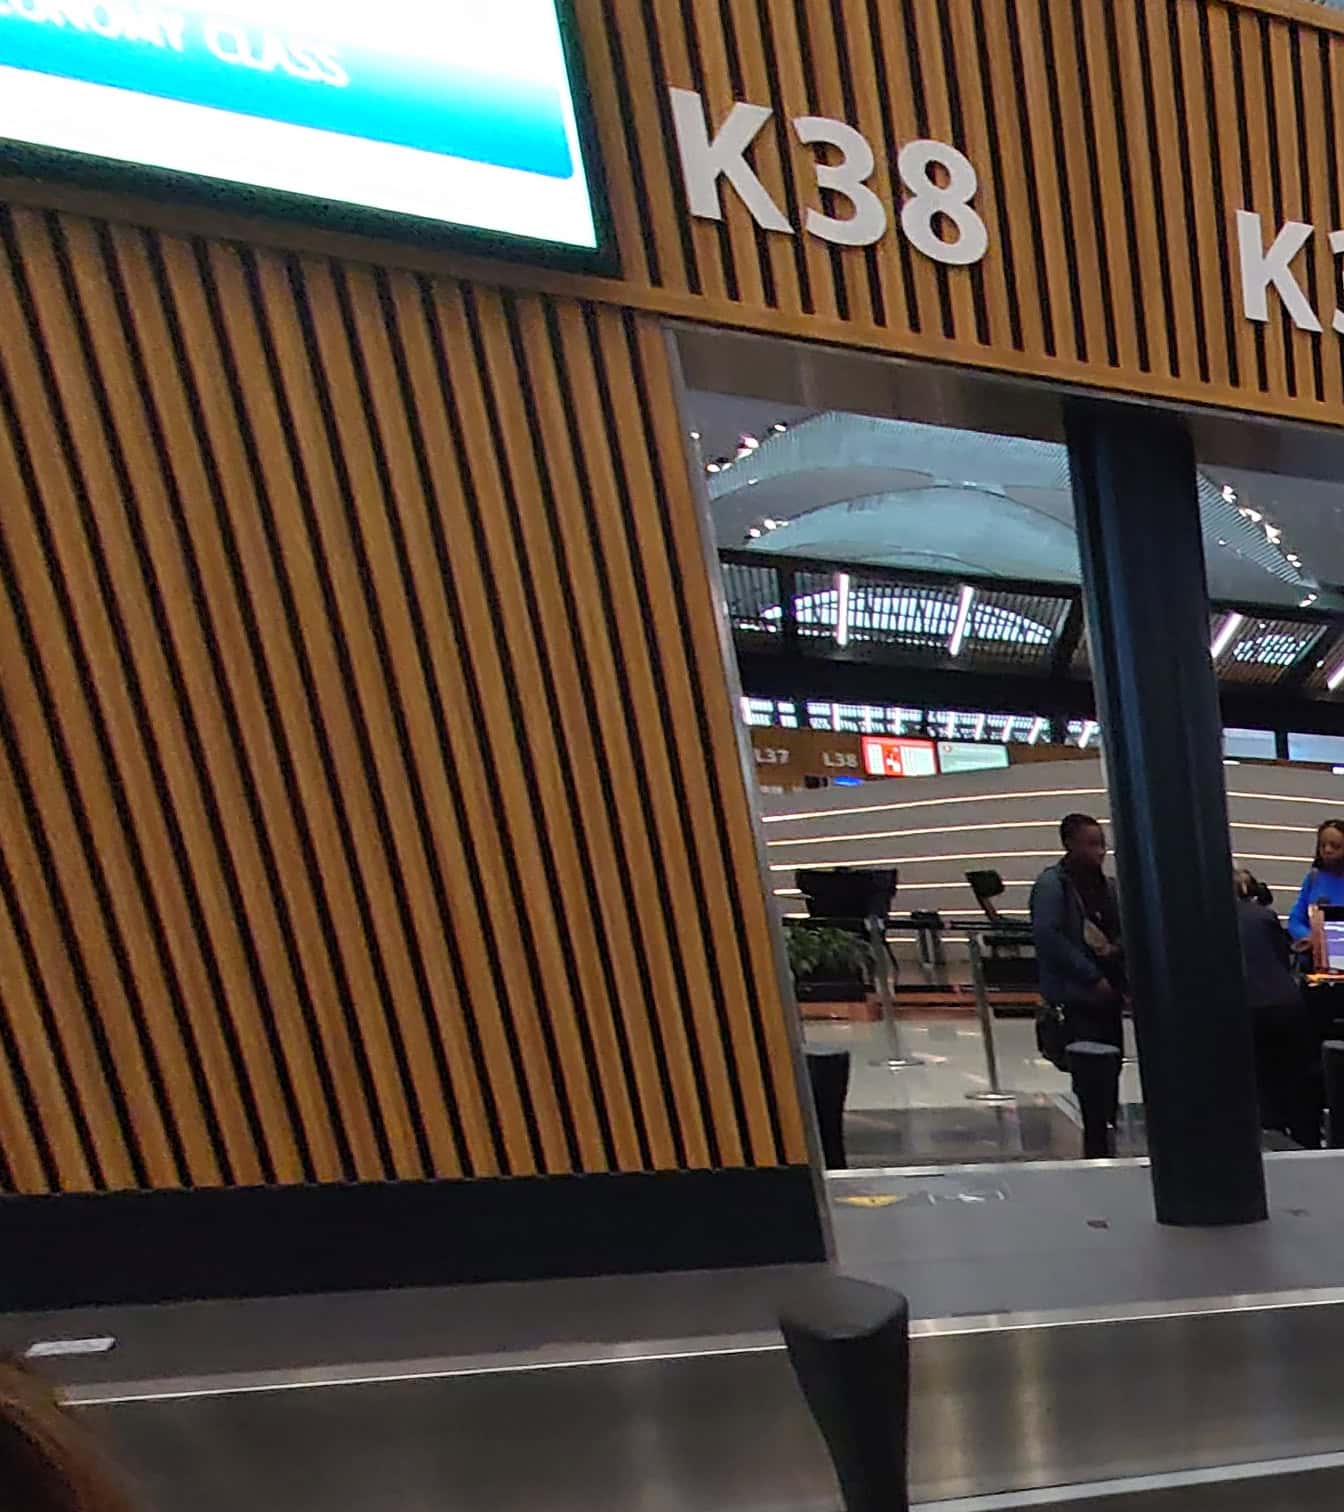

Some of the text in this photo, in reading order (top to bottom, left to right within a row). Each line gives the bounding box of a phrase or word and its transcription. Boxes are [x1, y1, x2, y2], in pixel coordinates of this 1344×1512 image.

[0, 0, 185, 52] ONOMY
[669, 87, 989, 266] K38
[754, 748, 791, 764] L37
[822, 751, 859, 769] L38
